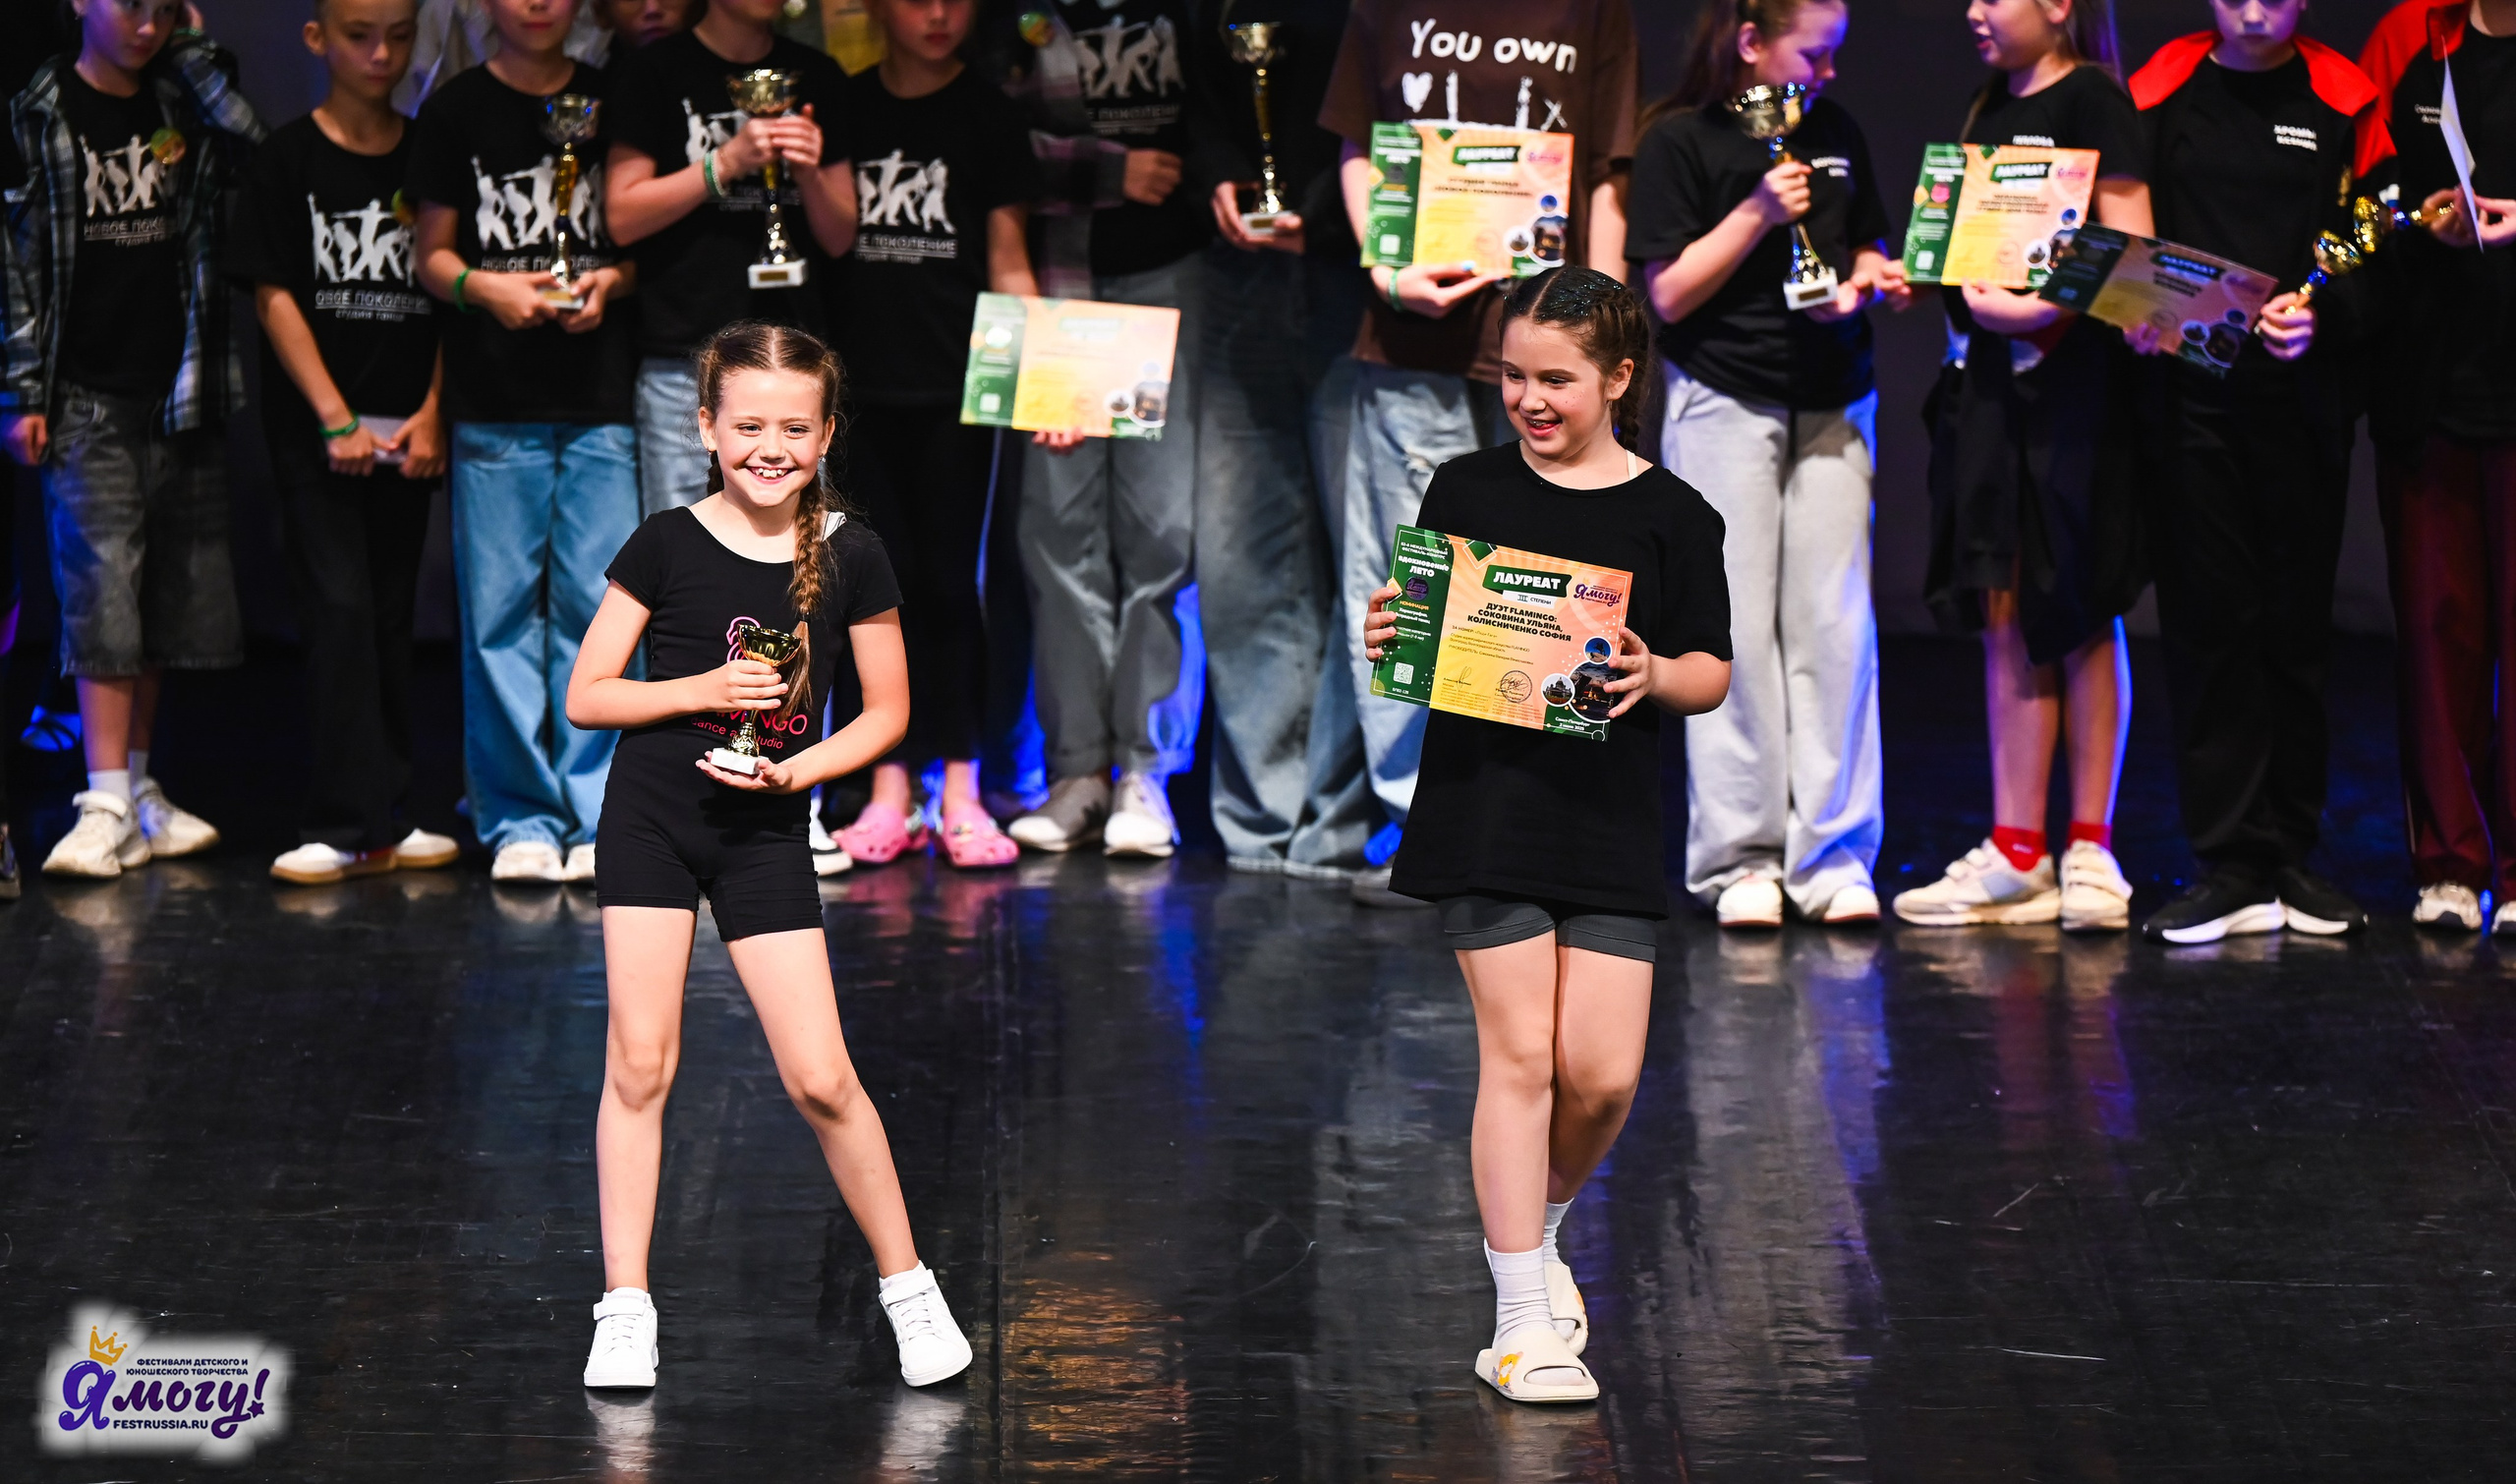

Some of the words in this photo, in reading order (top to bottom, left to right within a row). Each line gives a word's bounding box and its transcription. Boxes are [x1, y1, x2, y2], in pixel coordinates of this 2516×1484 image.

[1410, 18, 1483, 63] You
[1493, 37, 1577, 74] own
[314, 289, 353, 307] ОВОЕ
[354, 291, 430, 311] ПОКОЛЕНИ
[1409, 565, 1435, 577] ЛЕТО
[1493, 571, 1561, 590] ЛАУРЕАТ
[1573, 583, 1588, 599] Я
[1585, 588, 1623, 607] могу!
[1477, 608, 1525, 625] СОКОВИНА
[1527, 619, 1564, 633] УЛЬЯНА,
[1485, 602, 1509, 613] ДУЭТ
[1510, 607, 1558, 622] FLAMINGO:
[1467, 615, 1538, 635] КОЛИСНИЧЕНКО
[1539, 630, 1572, 642] СОФИЯ
[691, 716, 726, 734] dance
[756, 734, 783, 750] tudio
